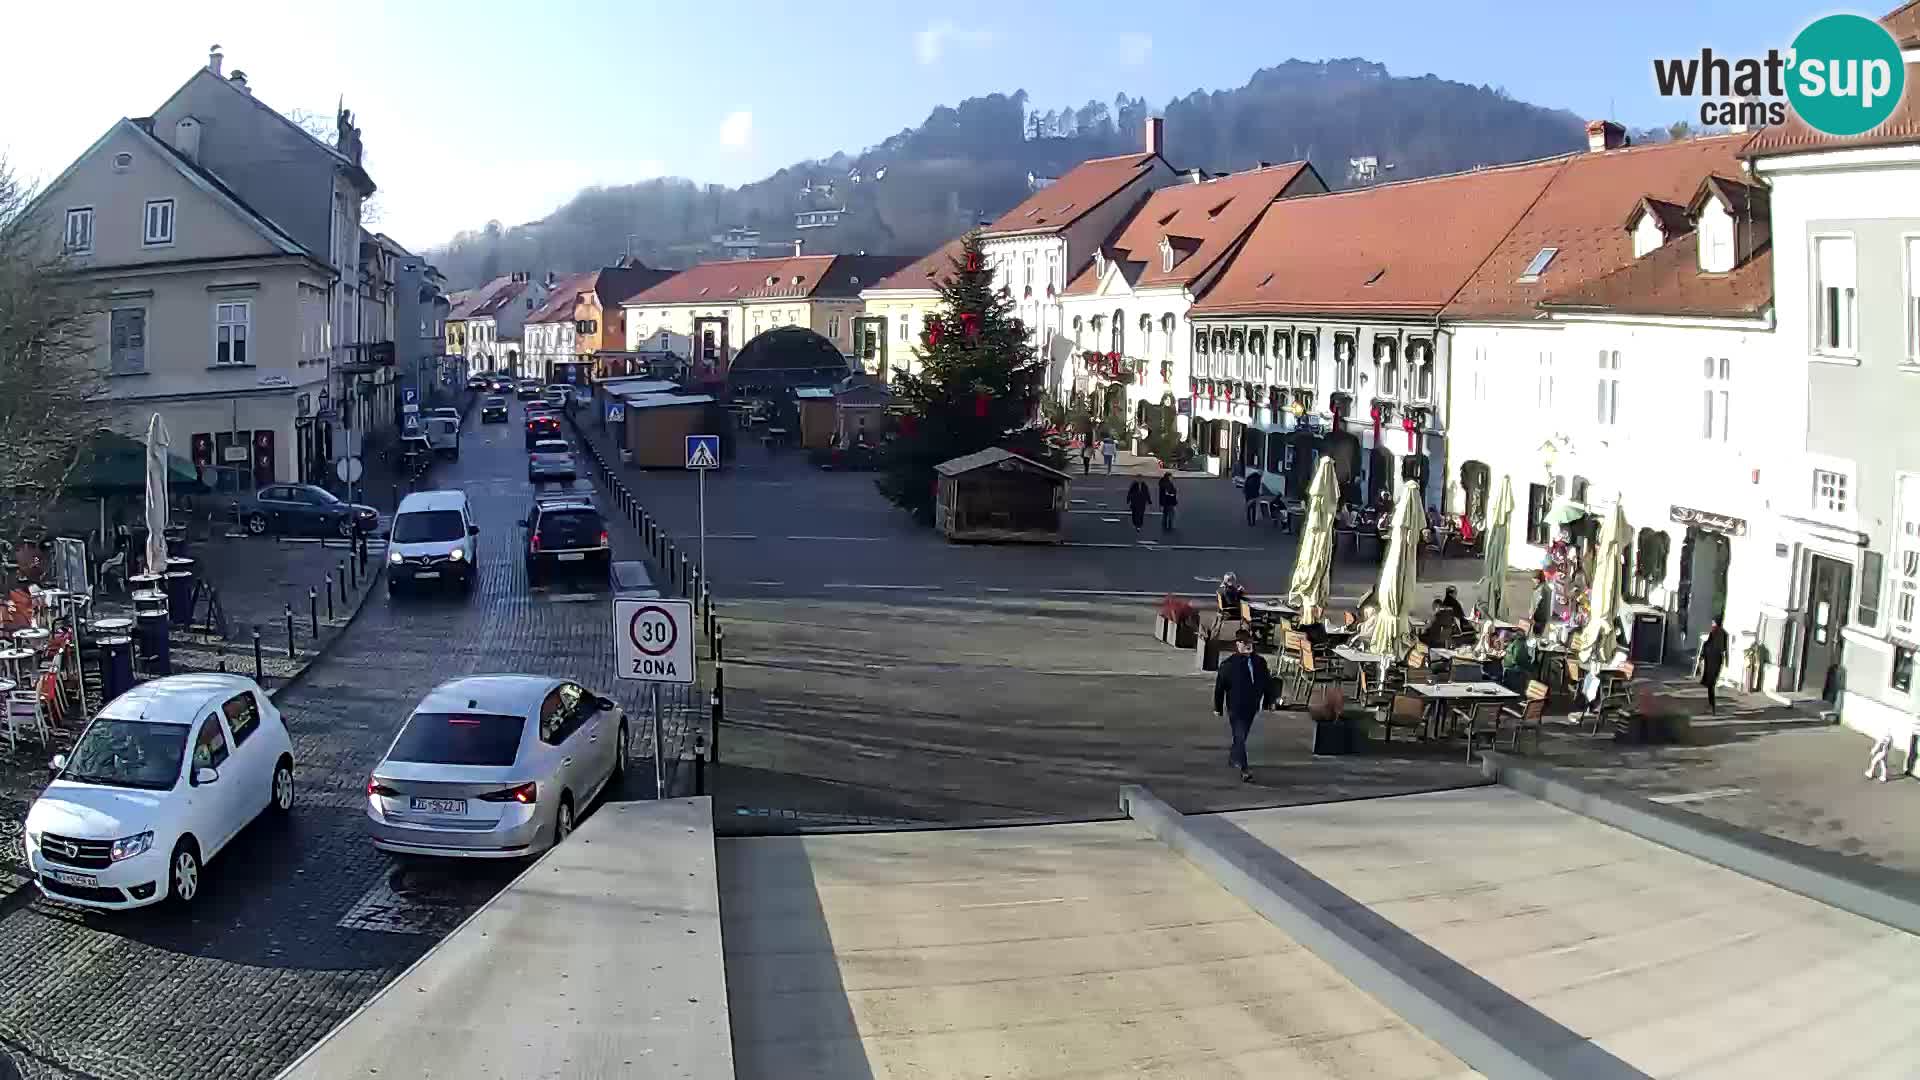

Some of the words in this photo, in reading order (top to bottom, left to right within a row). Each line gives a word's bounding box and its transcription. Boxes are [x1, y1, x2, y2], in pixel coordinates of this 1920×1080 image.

[407, 391, 414, 401] P
[642, 621, 666, 642] 30
[632, 658, 677, 676] ZONA
